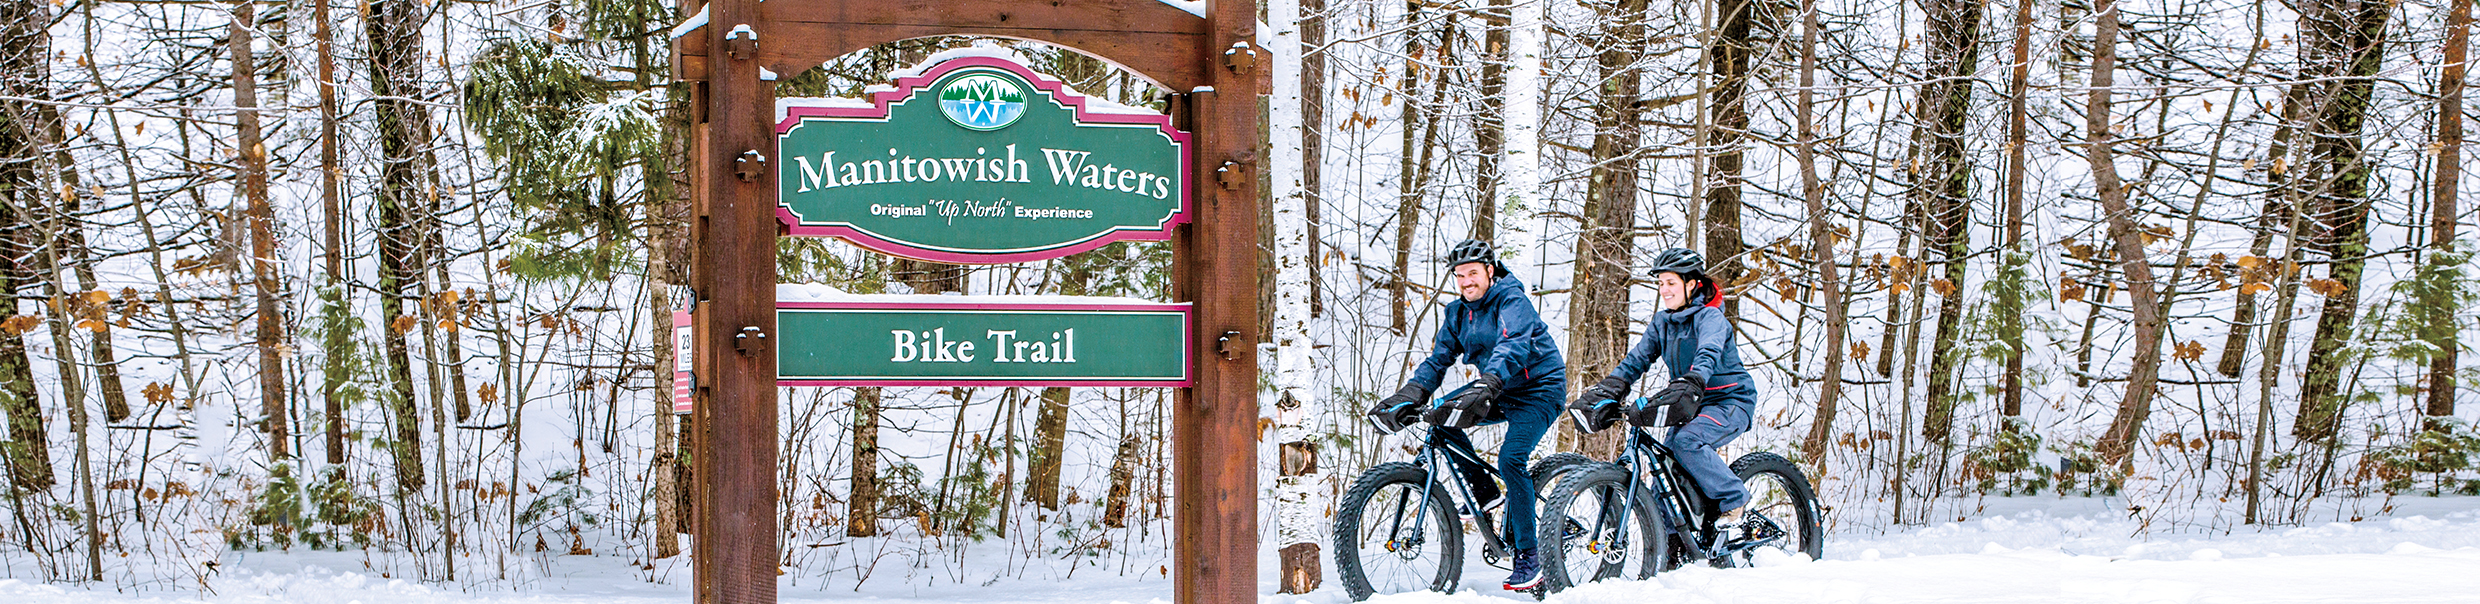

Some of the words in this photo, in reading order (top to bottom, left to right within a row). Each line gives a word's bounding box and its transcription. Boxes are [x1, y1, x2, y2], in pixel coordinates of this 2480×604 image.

[794, 143, 1030, 194] Manitowish
[1040, 147, 1171, 200] Waters
[870, 204, 926, 218] Original
[928, 199, 960, 226] "Up
[962, 197, 1012, 218] North"
[1014, 206, 1094, 220] Experience
[681, 334, 691, 350] 23
[890, 327, 975, 363] Bike
[986, 327, 1077, 363] Trail
